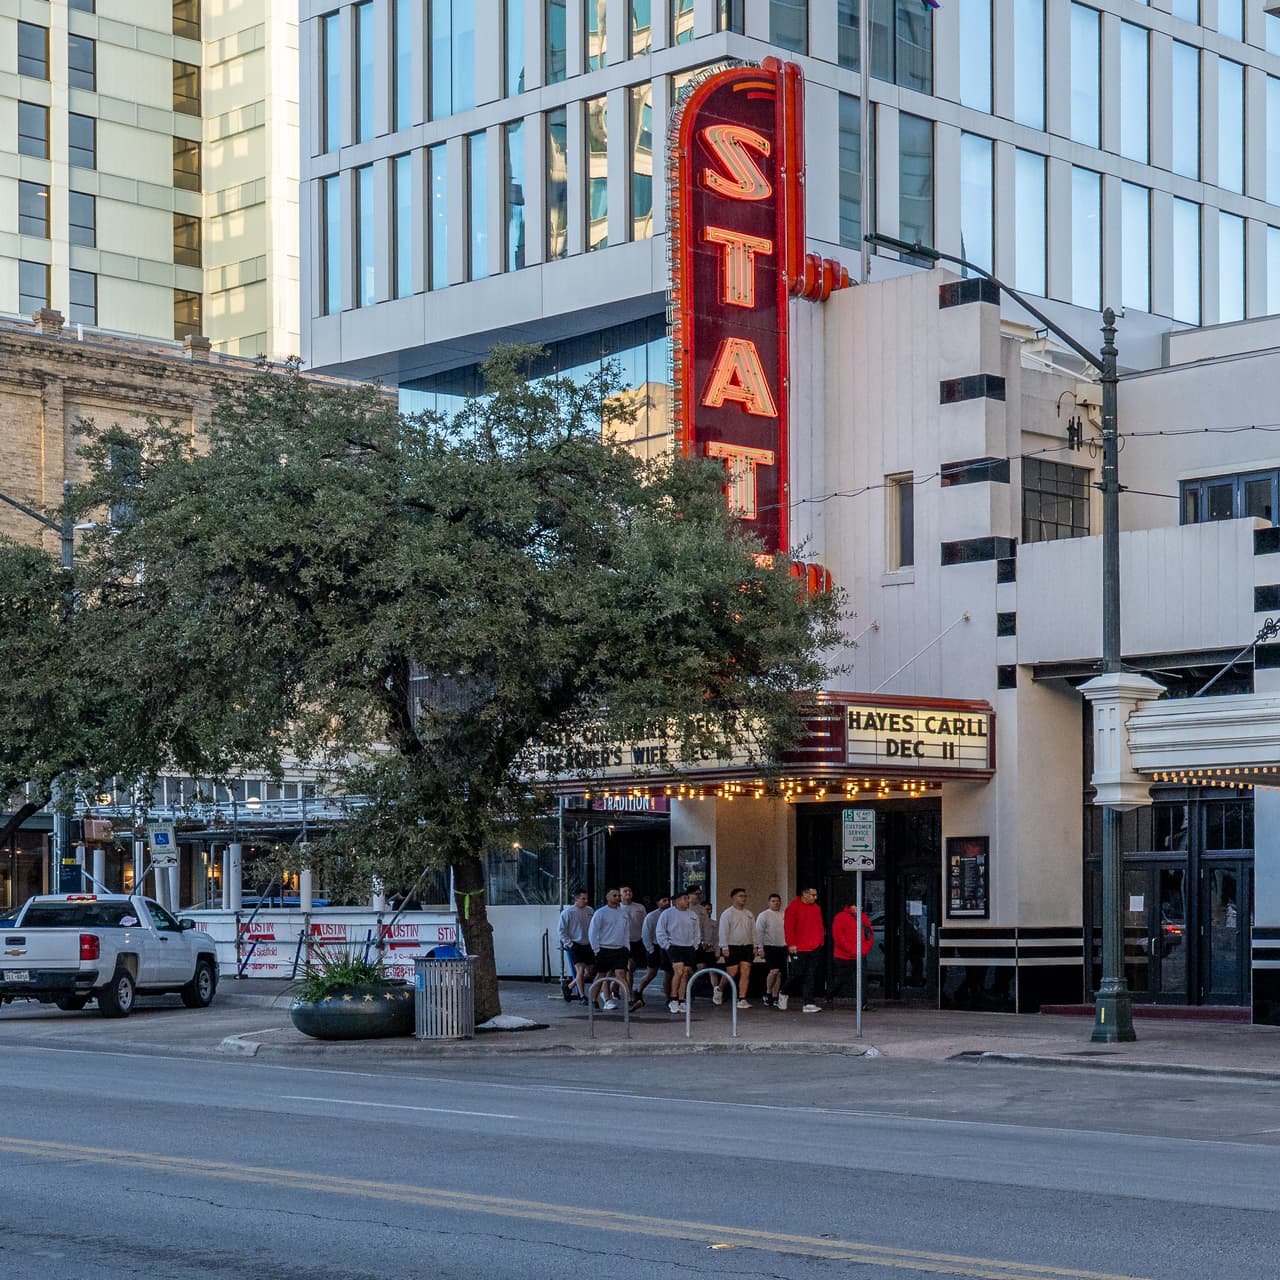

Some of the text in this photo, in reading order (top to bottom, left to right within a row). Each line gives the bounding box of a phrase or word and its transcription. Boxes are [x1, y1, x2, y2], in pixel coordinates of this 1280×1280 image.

[848, 710, 988, 737] HAYES CARLL
[886, 738, 925, 758] DEC
[310, 923, 347, 937] AUSTIN
